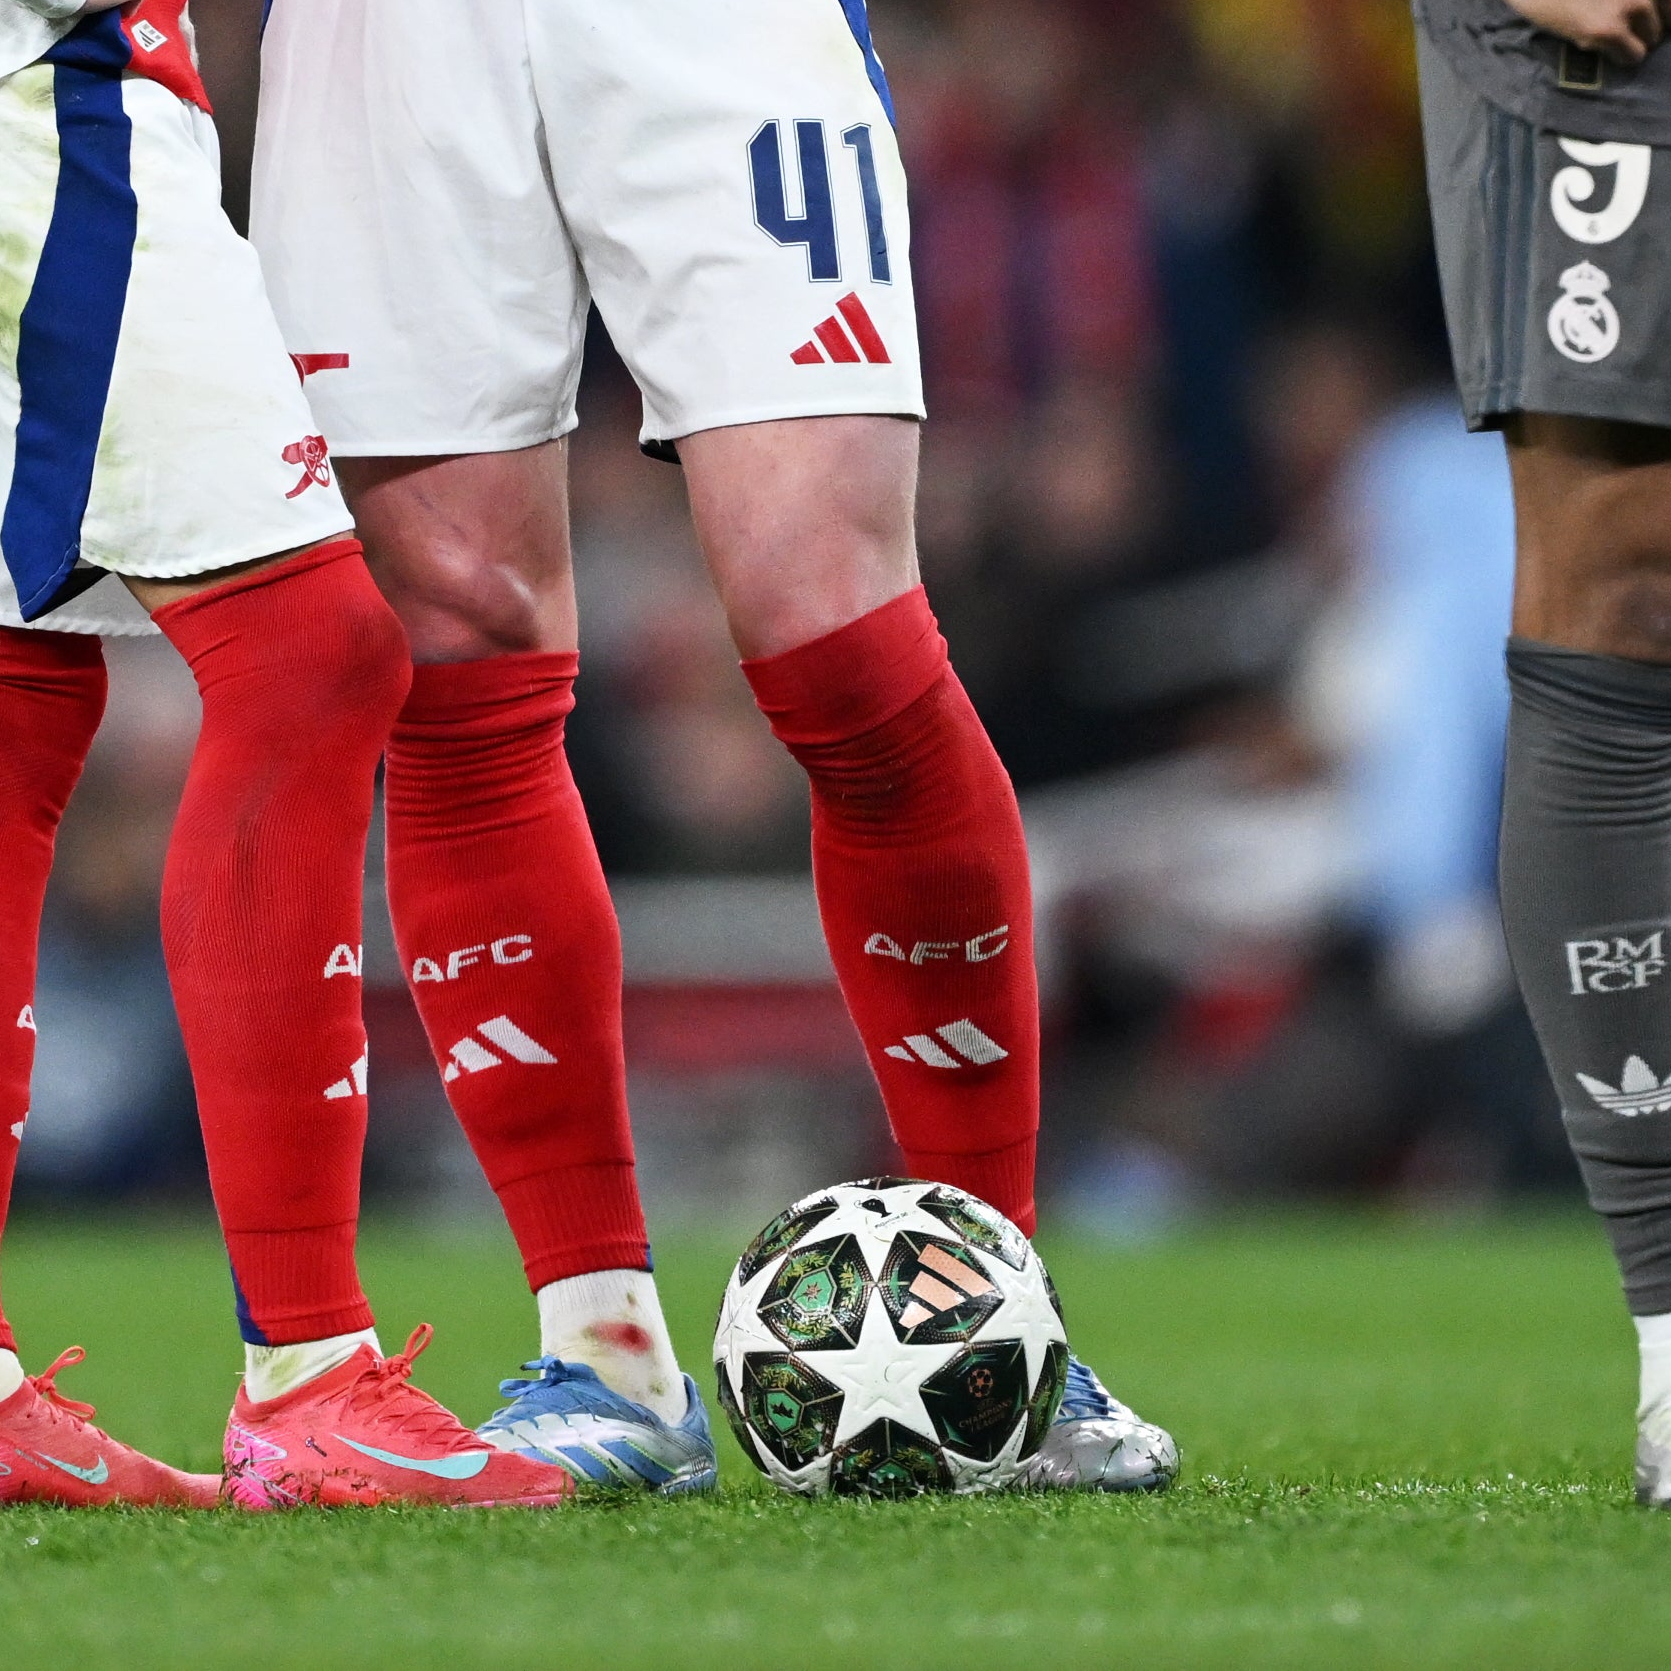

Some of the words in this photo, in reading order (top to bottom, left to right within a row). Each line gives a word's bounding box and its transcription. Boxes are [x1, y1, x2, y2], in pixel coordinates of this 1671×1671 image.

[745, 117, 892, 286] 41
[1550, 136, 1652, 245] 9
[323, 943, 364, 979] A
[412, 934, 534, 984] AFC
[864, 924, 1009, 966] AFC
